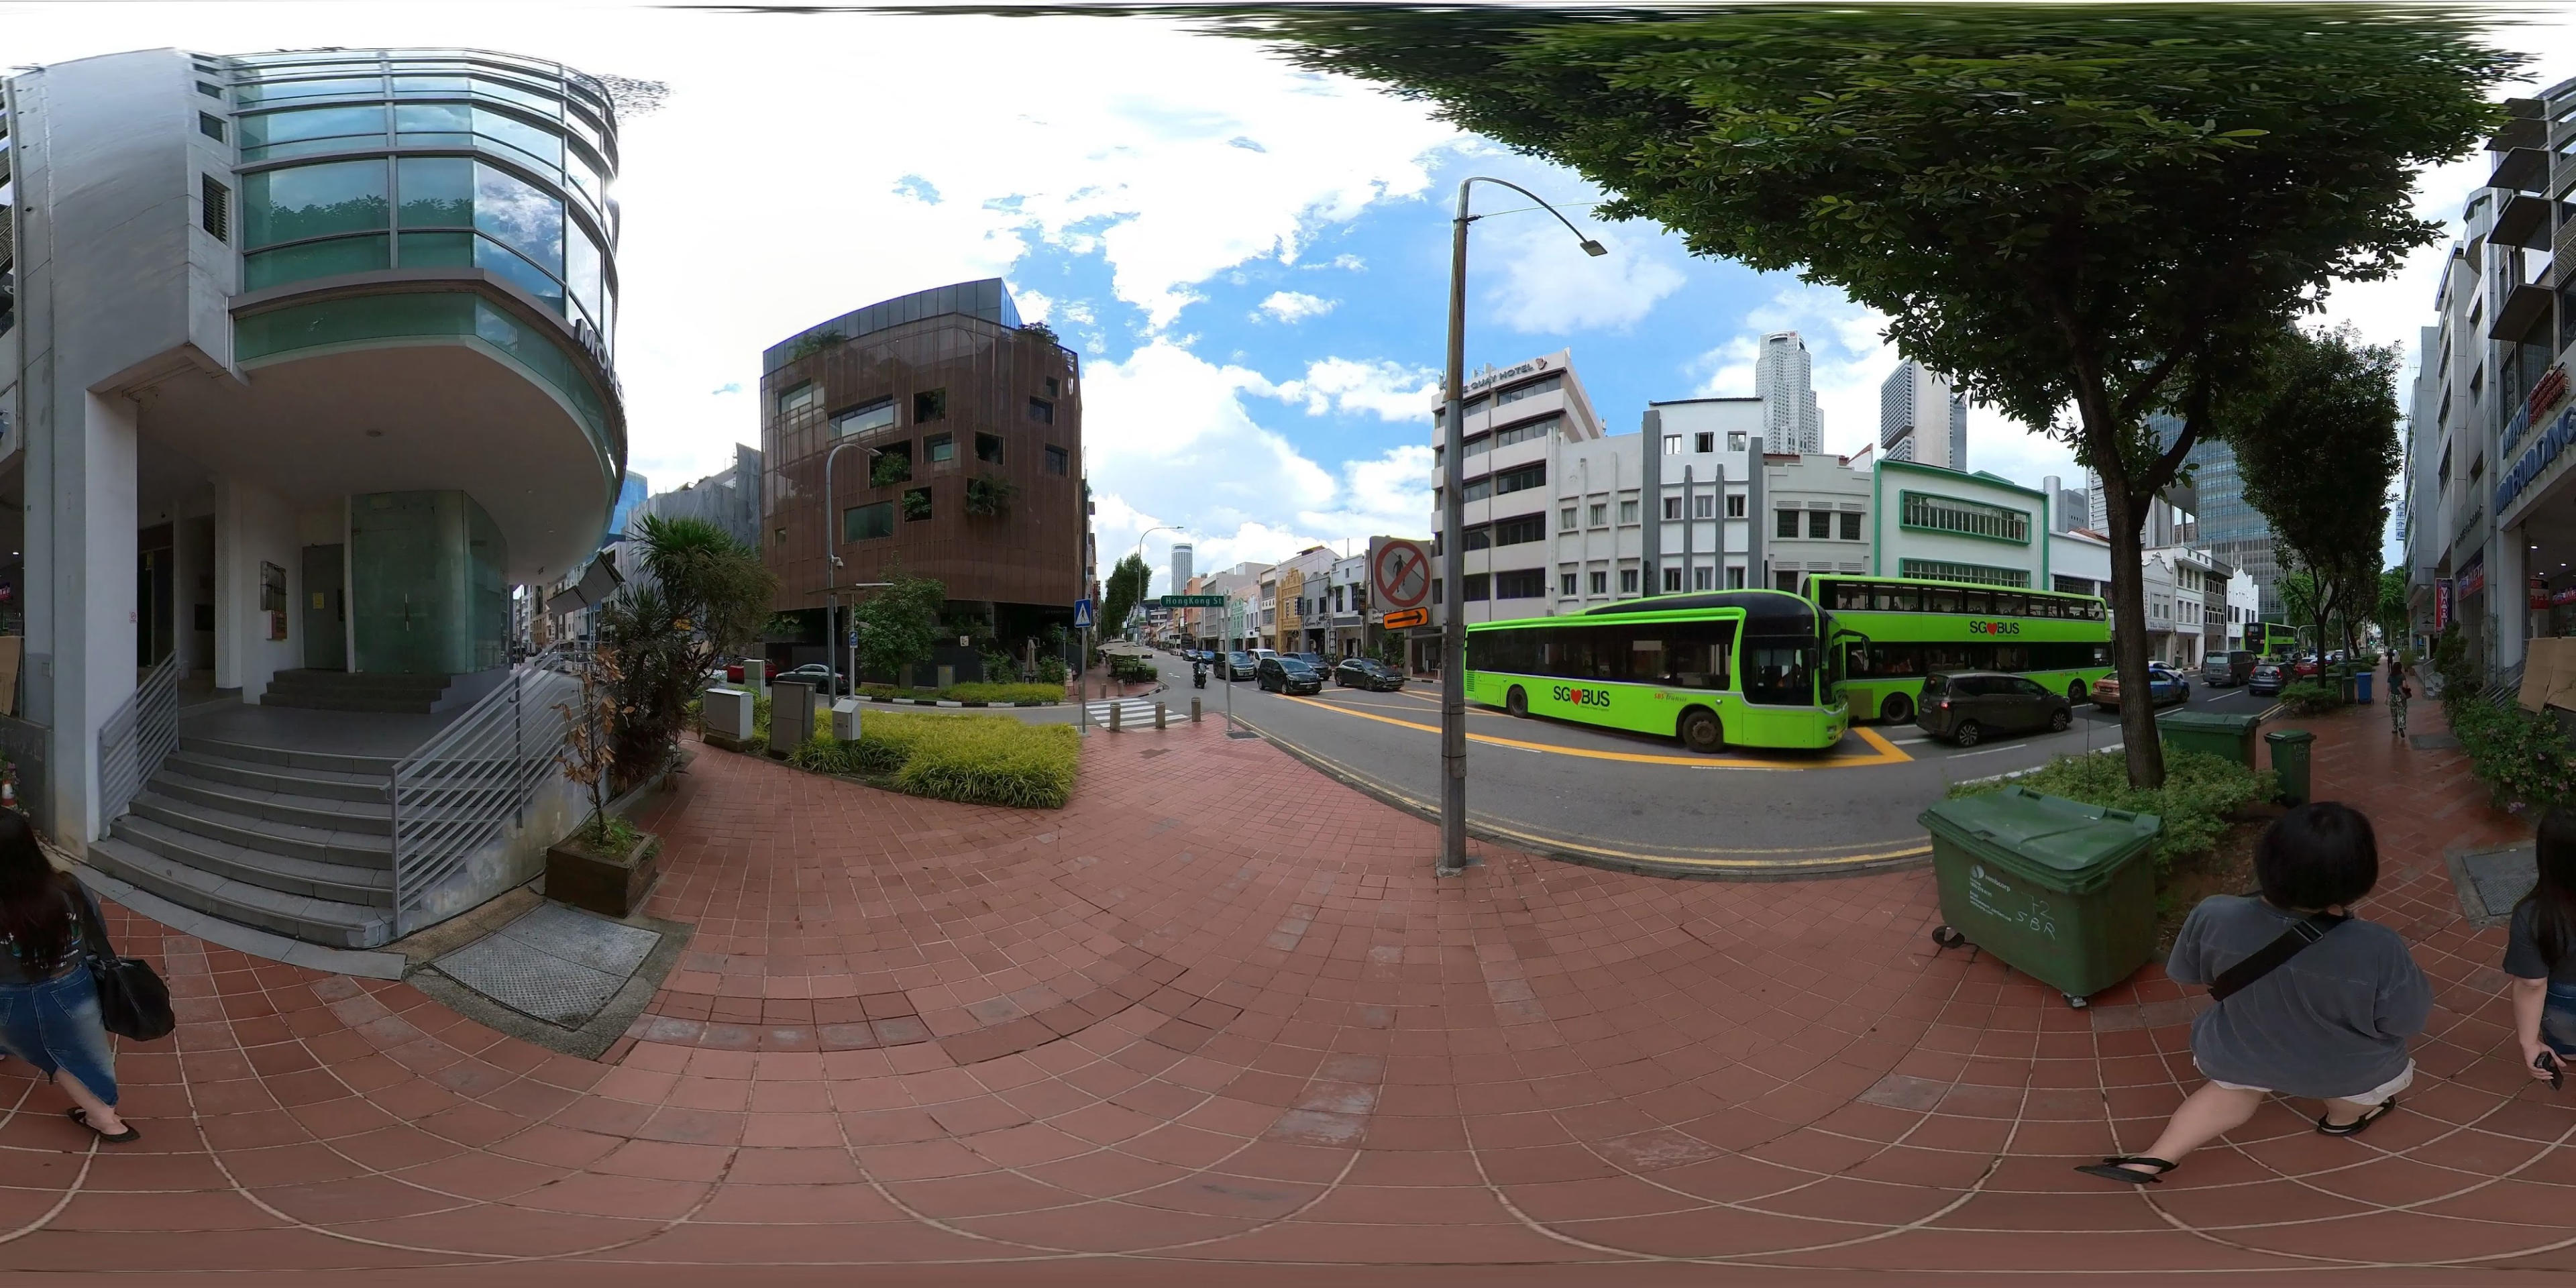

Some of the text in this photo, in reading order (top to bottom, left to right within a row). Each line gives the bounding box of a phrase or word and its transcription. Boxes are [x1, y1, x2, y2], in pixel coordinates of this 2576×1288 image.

[1471, 375, 1497, 390] QUAY
[1499, 364, 1534, 380] HOTEL
[1213, 596, 1222, 604] St
